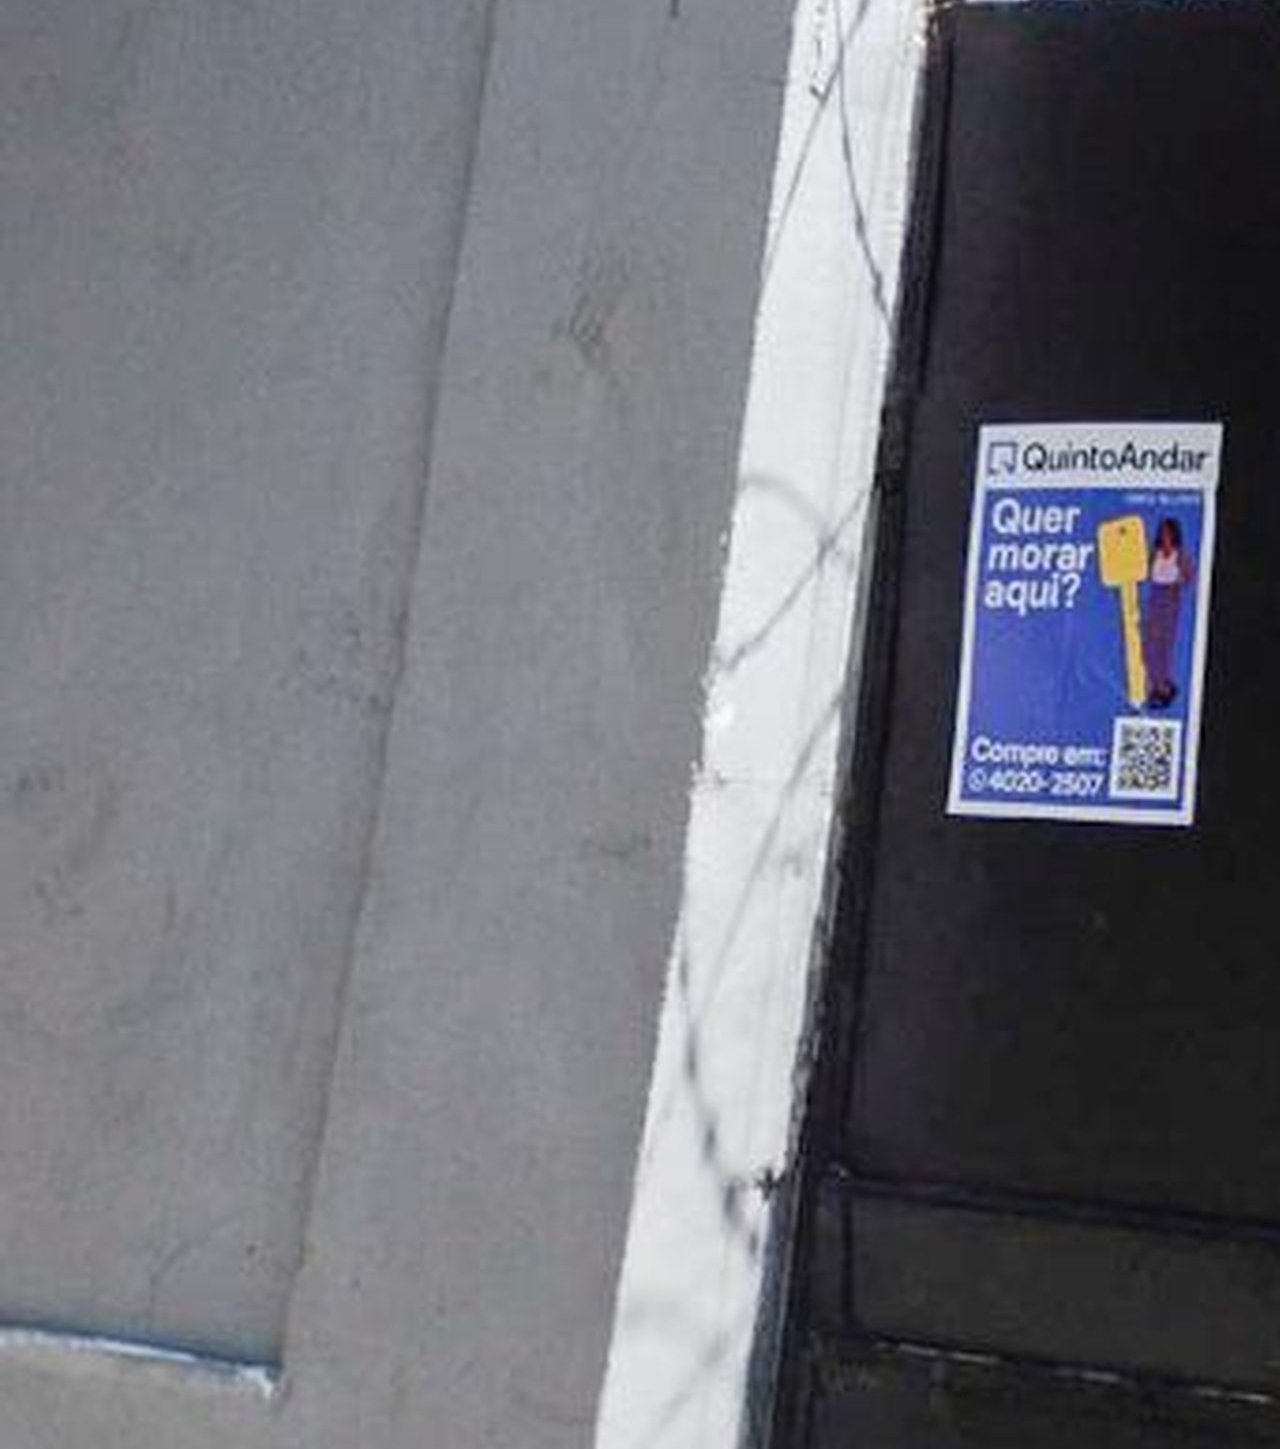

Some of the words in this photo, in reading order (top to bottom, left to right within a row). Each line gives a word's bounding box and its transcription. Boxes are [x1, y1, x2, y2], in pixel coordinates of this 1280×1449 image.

[1022, 441, 1211, 473] QuintoAndar
[992, 498, 1081, 535] Quer
[989, 543, 1095, 570] morar
[985, 572, 1082, 617] aqui?
